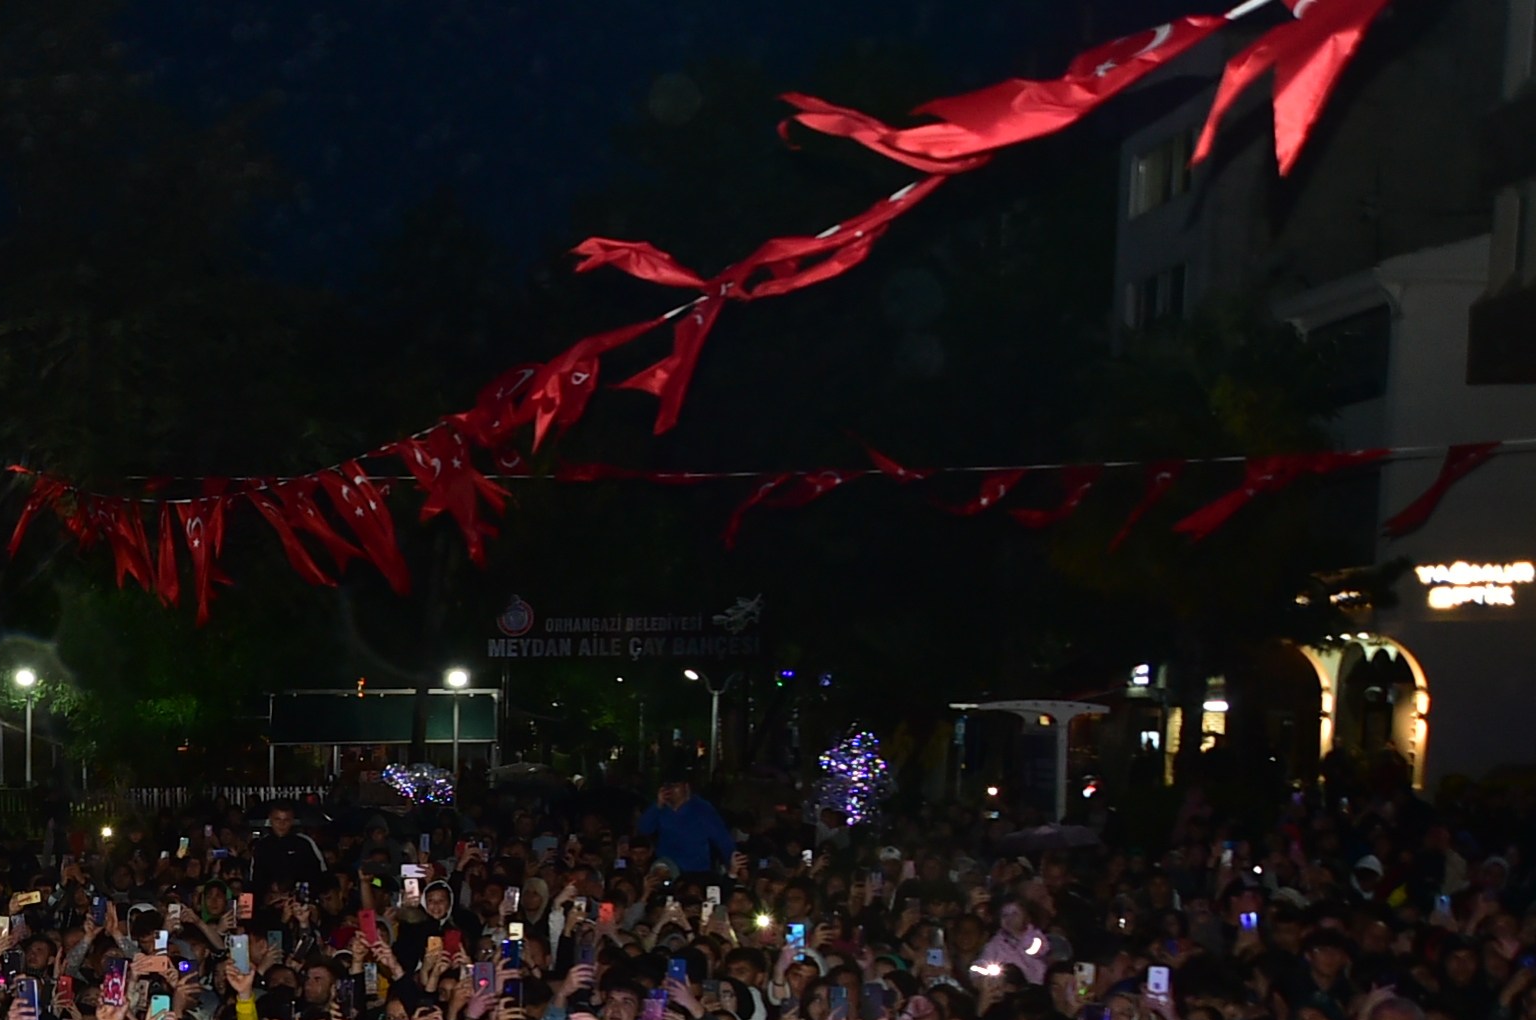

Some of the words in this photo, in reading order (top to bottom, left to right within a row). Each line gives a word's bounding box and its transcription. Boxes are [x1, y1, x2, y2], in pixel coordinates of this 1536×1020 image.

[545, 613, 622, 633] ORHANGAZİ
[626, 612, 702, 632] BELEDİYESİ
[488, 637, 571, 657] MEYDAN
[578, 632, 621, 657] AİLE
[629, 637, 666, 660] ÇAY
[672, 632, 761, 659] BAHÇESİ
